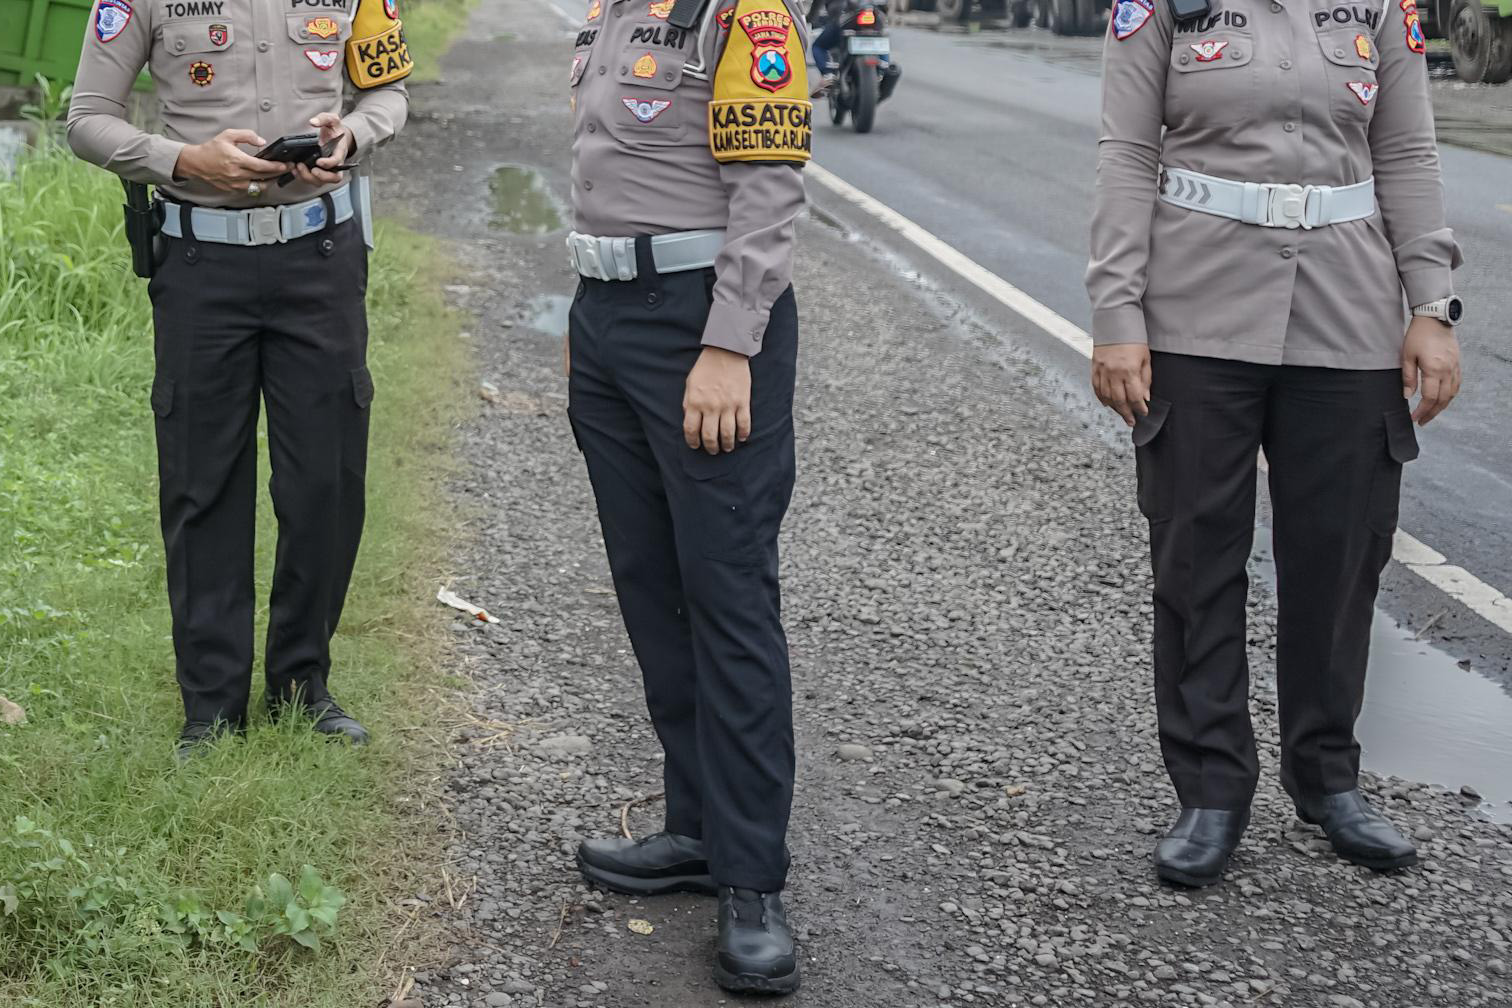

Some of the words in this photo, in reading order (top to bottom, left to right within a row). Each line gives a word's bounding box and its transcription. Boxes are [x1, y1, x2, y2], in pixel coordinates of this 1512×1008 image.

[165, 0, 225, 18] TOMMY
[743, 11, 791, 26] POLRES
[1314, 5, 1379, 30] POLRI
[630, 26, 688, 50] POLRI
